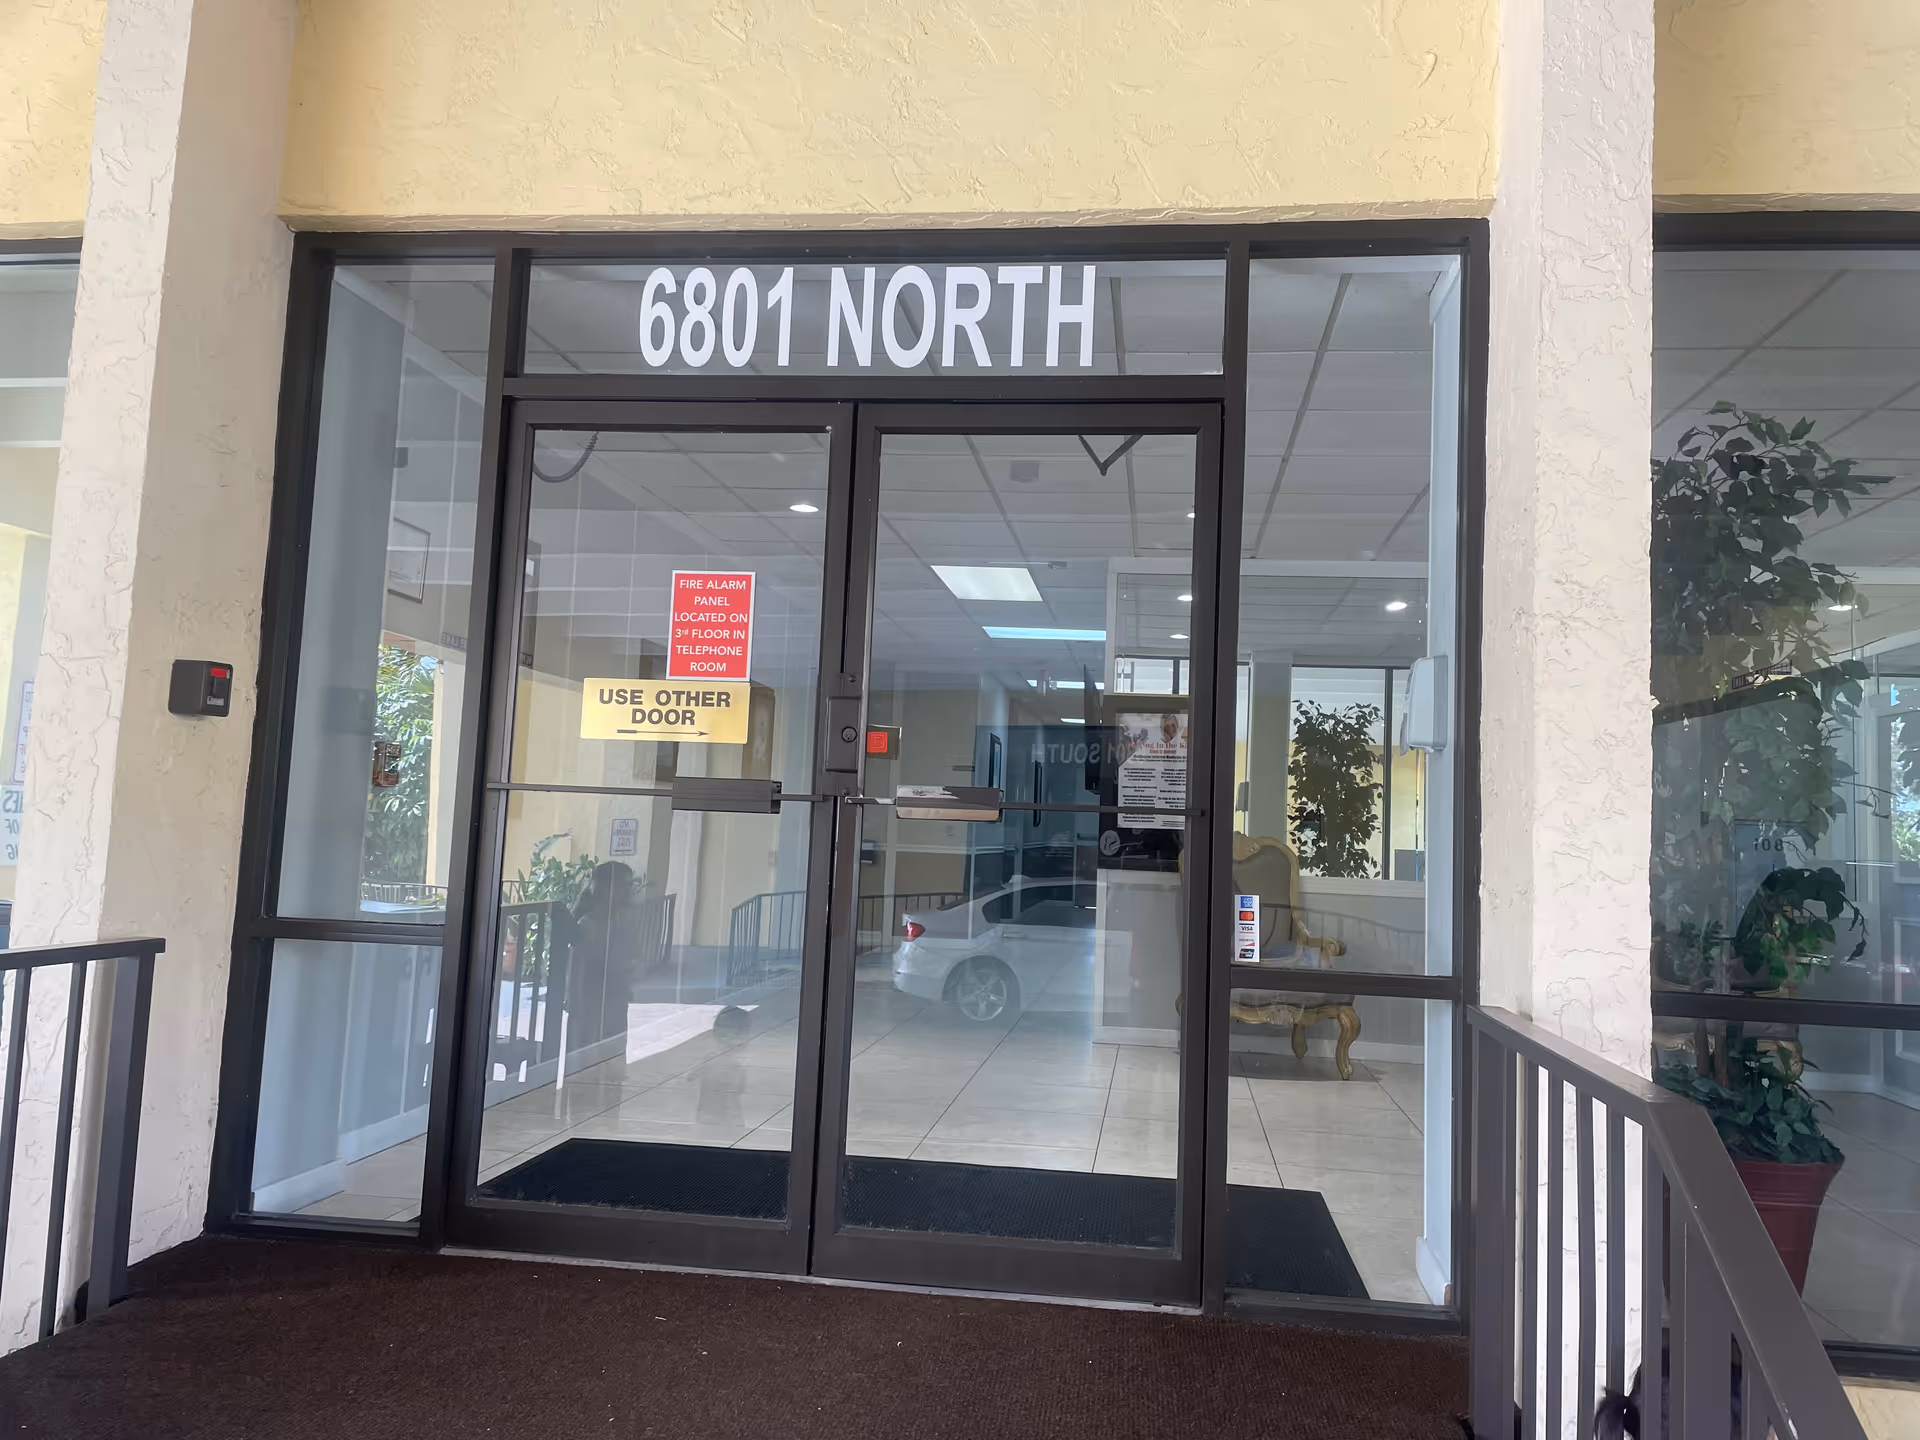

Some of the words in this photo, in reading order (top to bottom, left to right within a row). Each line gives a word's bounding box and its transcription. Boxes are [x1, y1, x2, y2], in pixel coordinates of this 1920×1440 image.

[639, 266, 795, 368] 6801
[826, 264, 1097, 368] NORTH
[680, 579, 704, 589] FIRE
[706, 580, 746, 590] ALARM
[694, 596, 730, 606] PANEL
[674, 612, 726, 622] LOCATED
[729, 613, 748, 623] ON
[675, 628, 689, 638] 3rd
[691, 629, 730, 639] FLOOR
[733, 629, 746, 639] IN
[676, 645, 743, 656] TELEPHONE
[690, 662, 727, 672] ROOM
[599, 688, 644, 705] USE
[655, 689, 731, 708] OTHER
[631, 708, 696, 725] DOOR
